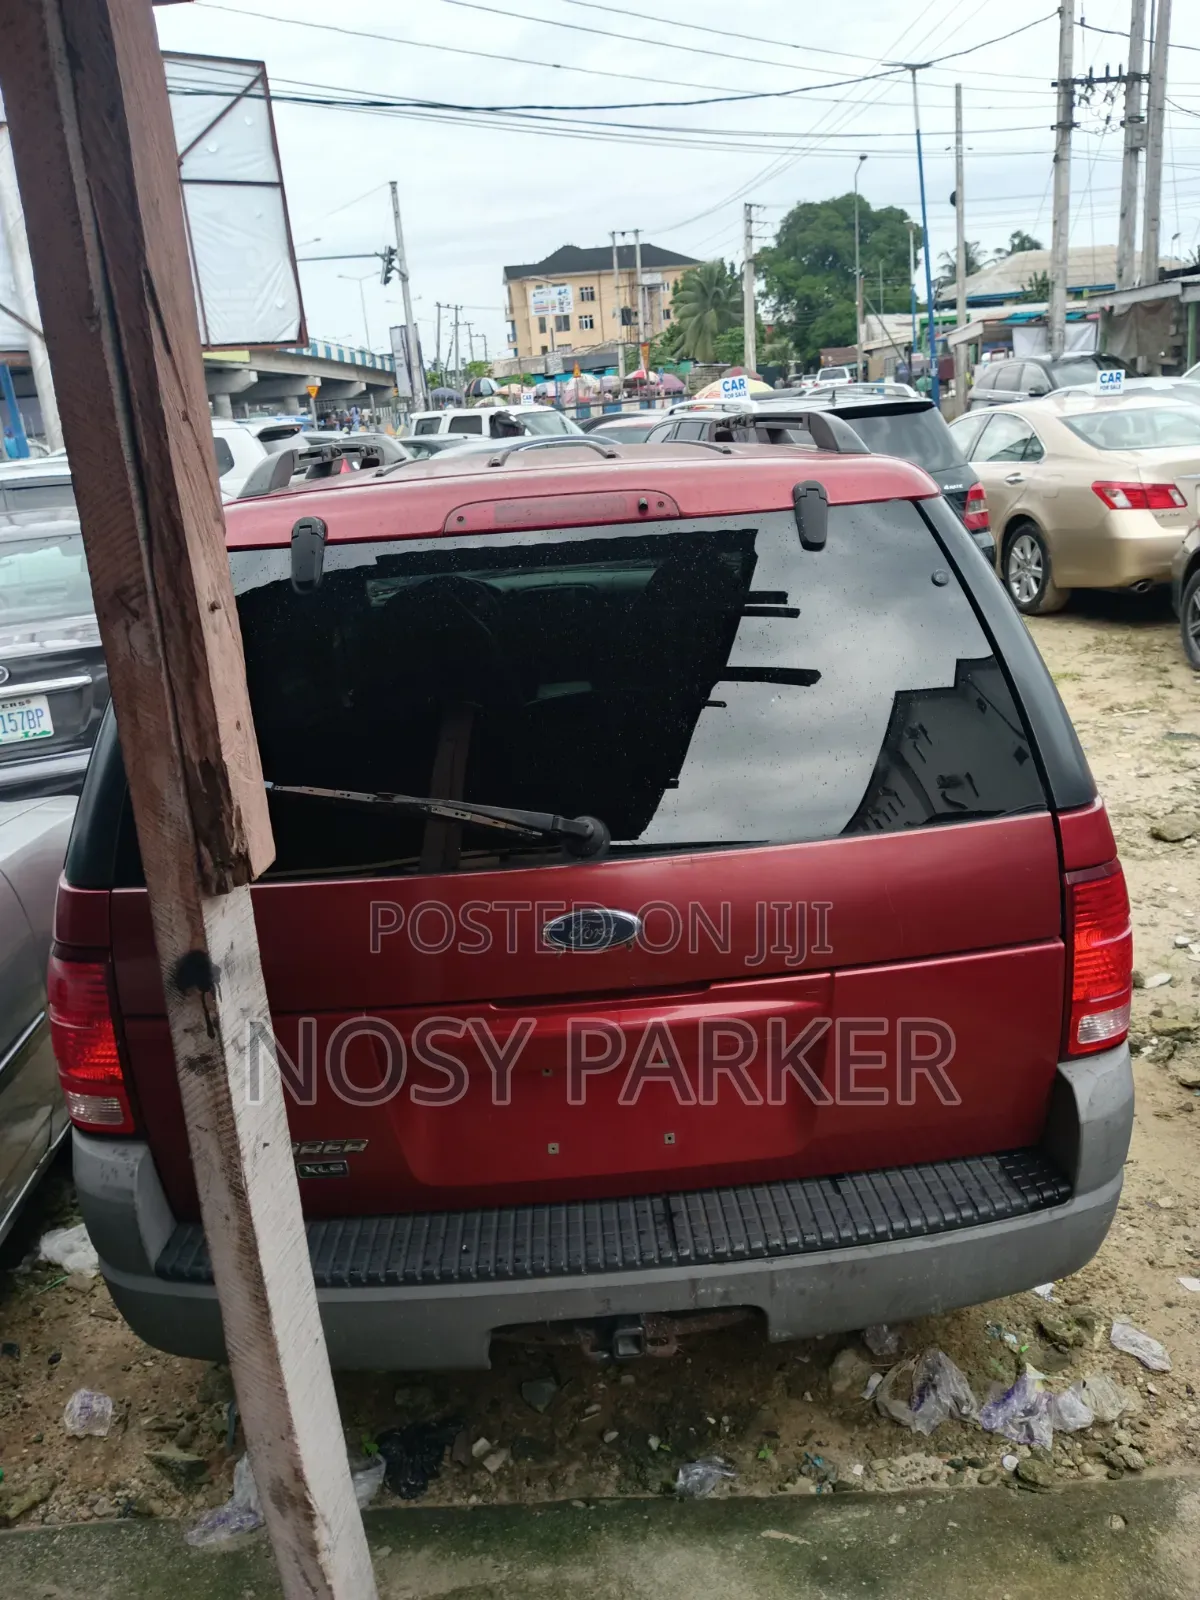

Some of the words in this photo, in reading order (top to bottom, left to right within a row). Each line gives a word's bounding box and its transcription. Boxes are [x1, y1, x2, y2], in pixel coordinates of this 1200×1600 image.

[722, 378, 746, 392] CAR
[1100, 372, 1122, 384] CAR
[568, 919, 617, 940] Ford
